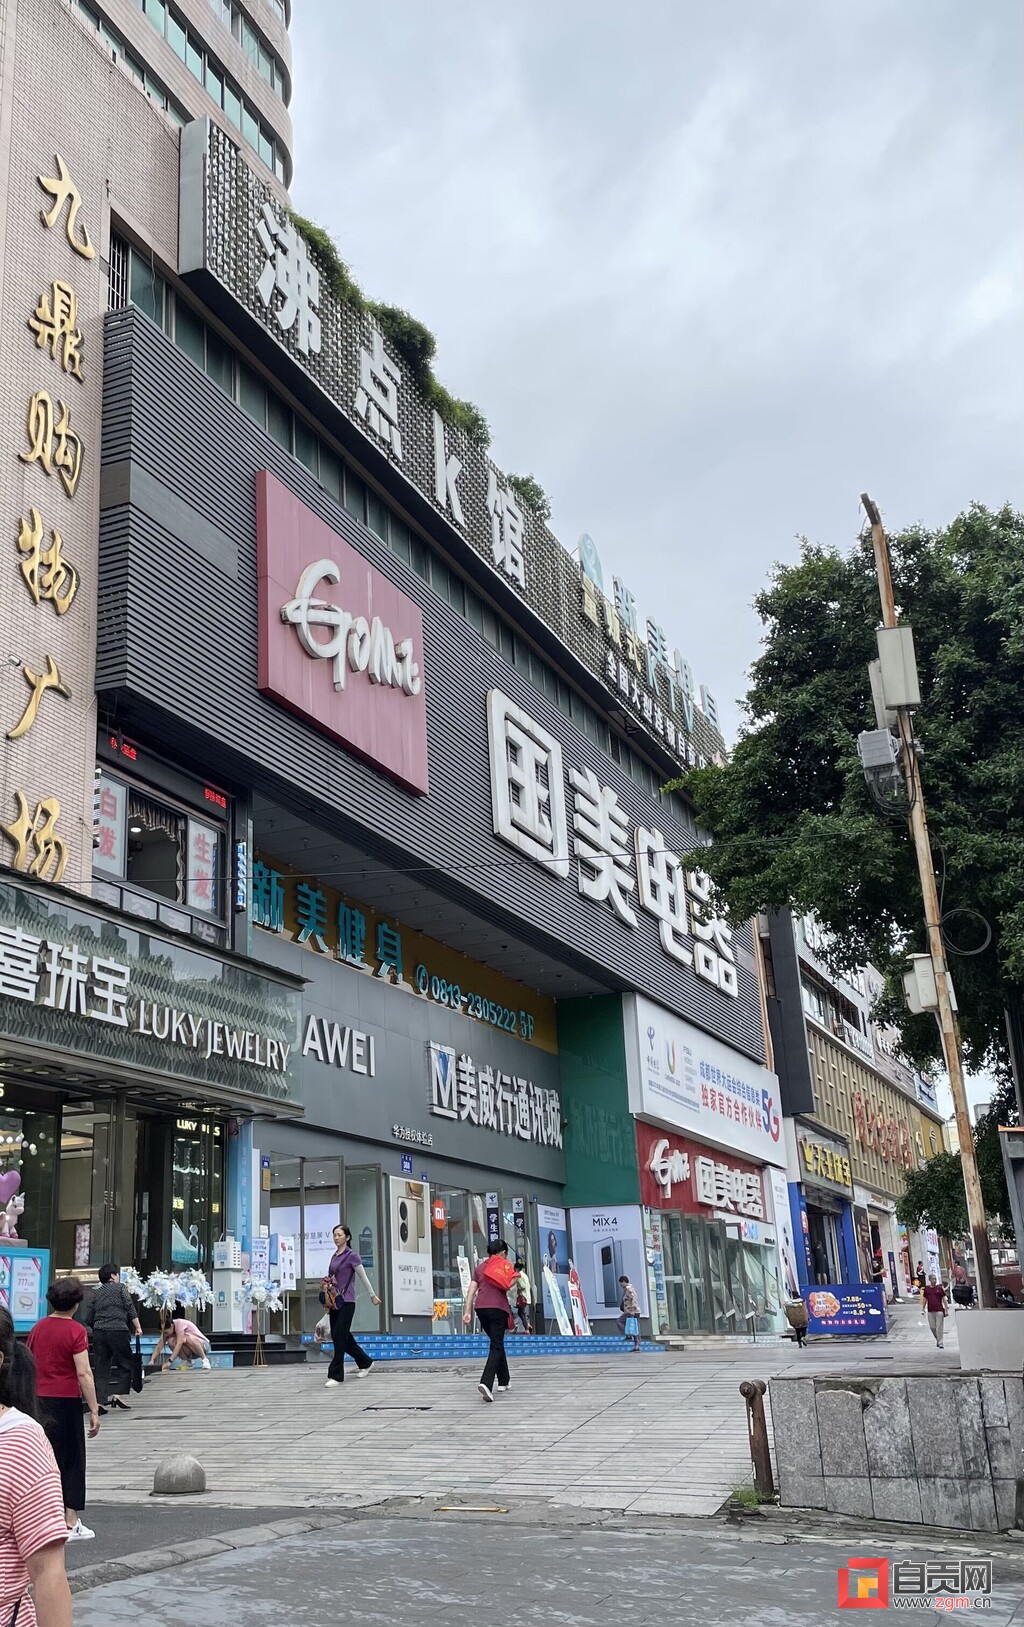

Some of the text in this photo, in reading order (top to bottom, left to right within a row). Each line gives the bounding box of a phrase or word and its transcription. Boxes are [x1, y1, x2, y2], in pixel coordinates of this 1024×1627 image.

[4, 153, 96, 882] 九鼎购物广场
[487, 688, 738, 998] 国美电器
[252, 860, 404, 985] 新美健身
[432, 976, 518, 1034] 0813-2305222
[138, 999, 291, 1072] LUKY JEWELRY
[457, 1053, 563, 1150] 美威行通讯城
[700, 1083, 763, 1132] 独家官方合作伙伴
[761, 1088, 780, 1143] 5G
[592, 1217, 618, 1227] MIX 4
[694, 1155, 764, 1220] 国美电器
